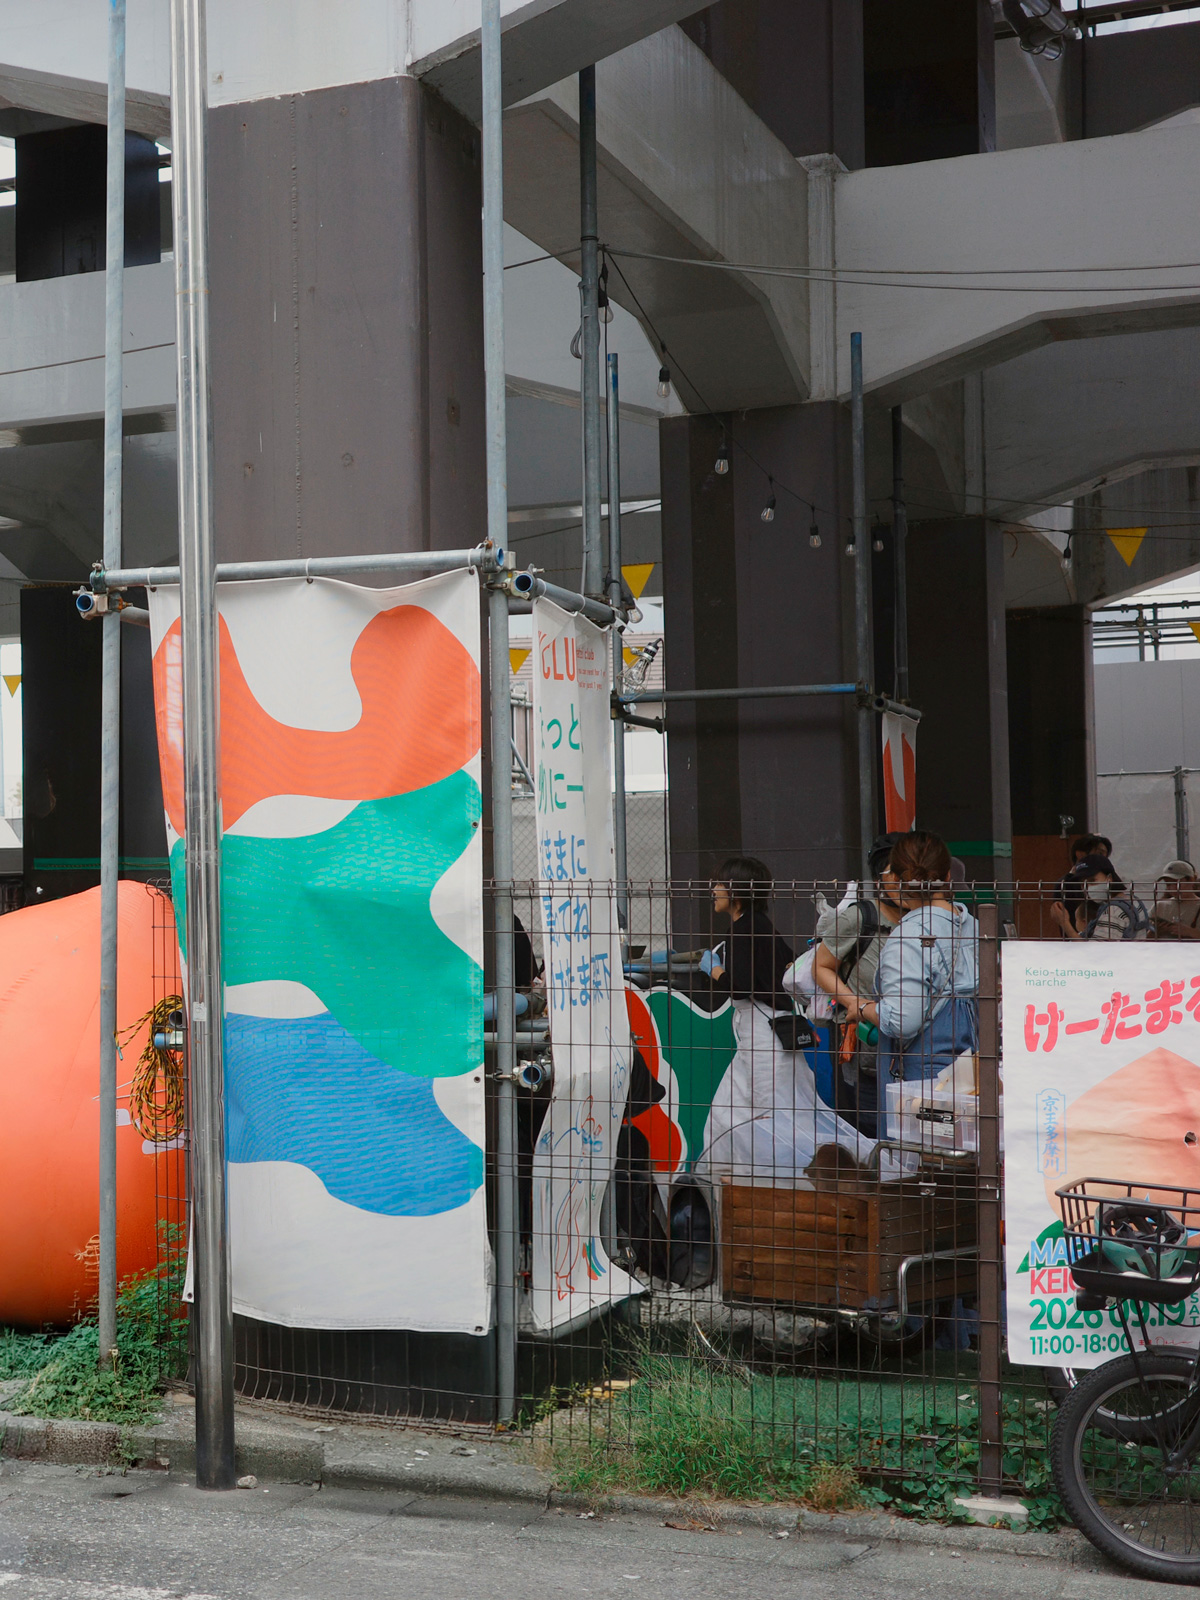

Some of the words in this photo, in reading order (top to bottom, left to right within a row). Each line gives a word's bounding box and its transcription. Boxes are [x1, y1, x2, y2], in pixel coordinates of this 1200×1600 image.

[1025, 967, 1114, 979] Keio-tamagawa
[1025, 978, 1067, 986] marche
[1042, 1095, 1062, 1173] 京王多摩川
[1189, 1292, 1200, 1327] SAT
[1029, 1333, 1132, 1355] 11:00-18:00
